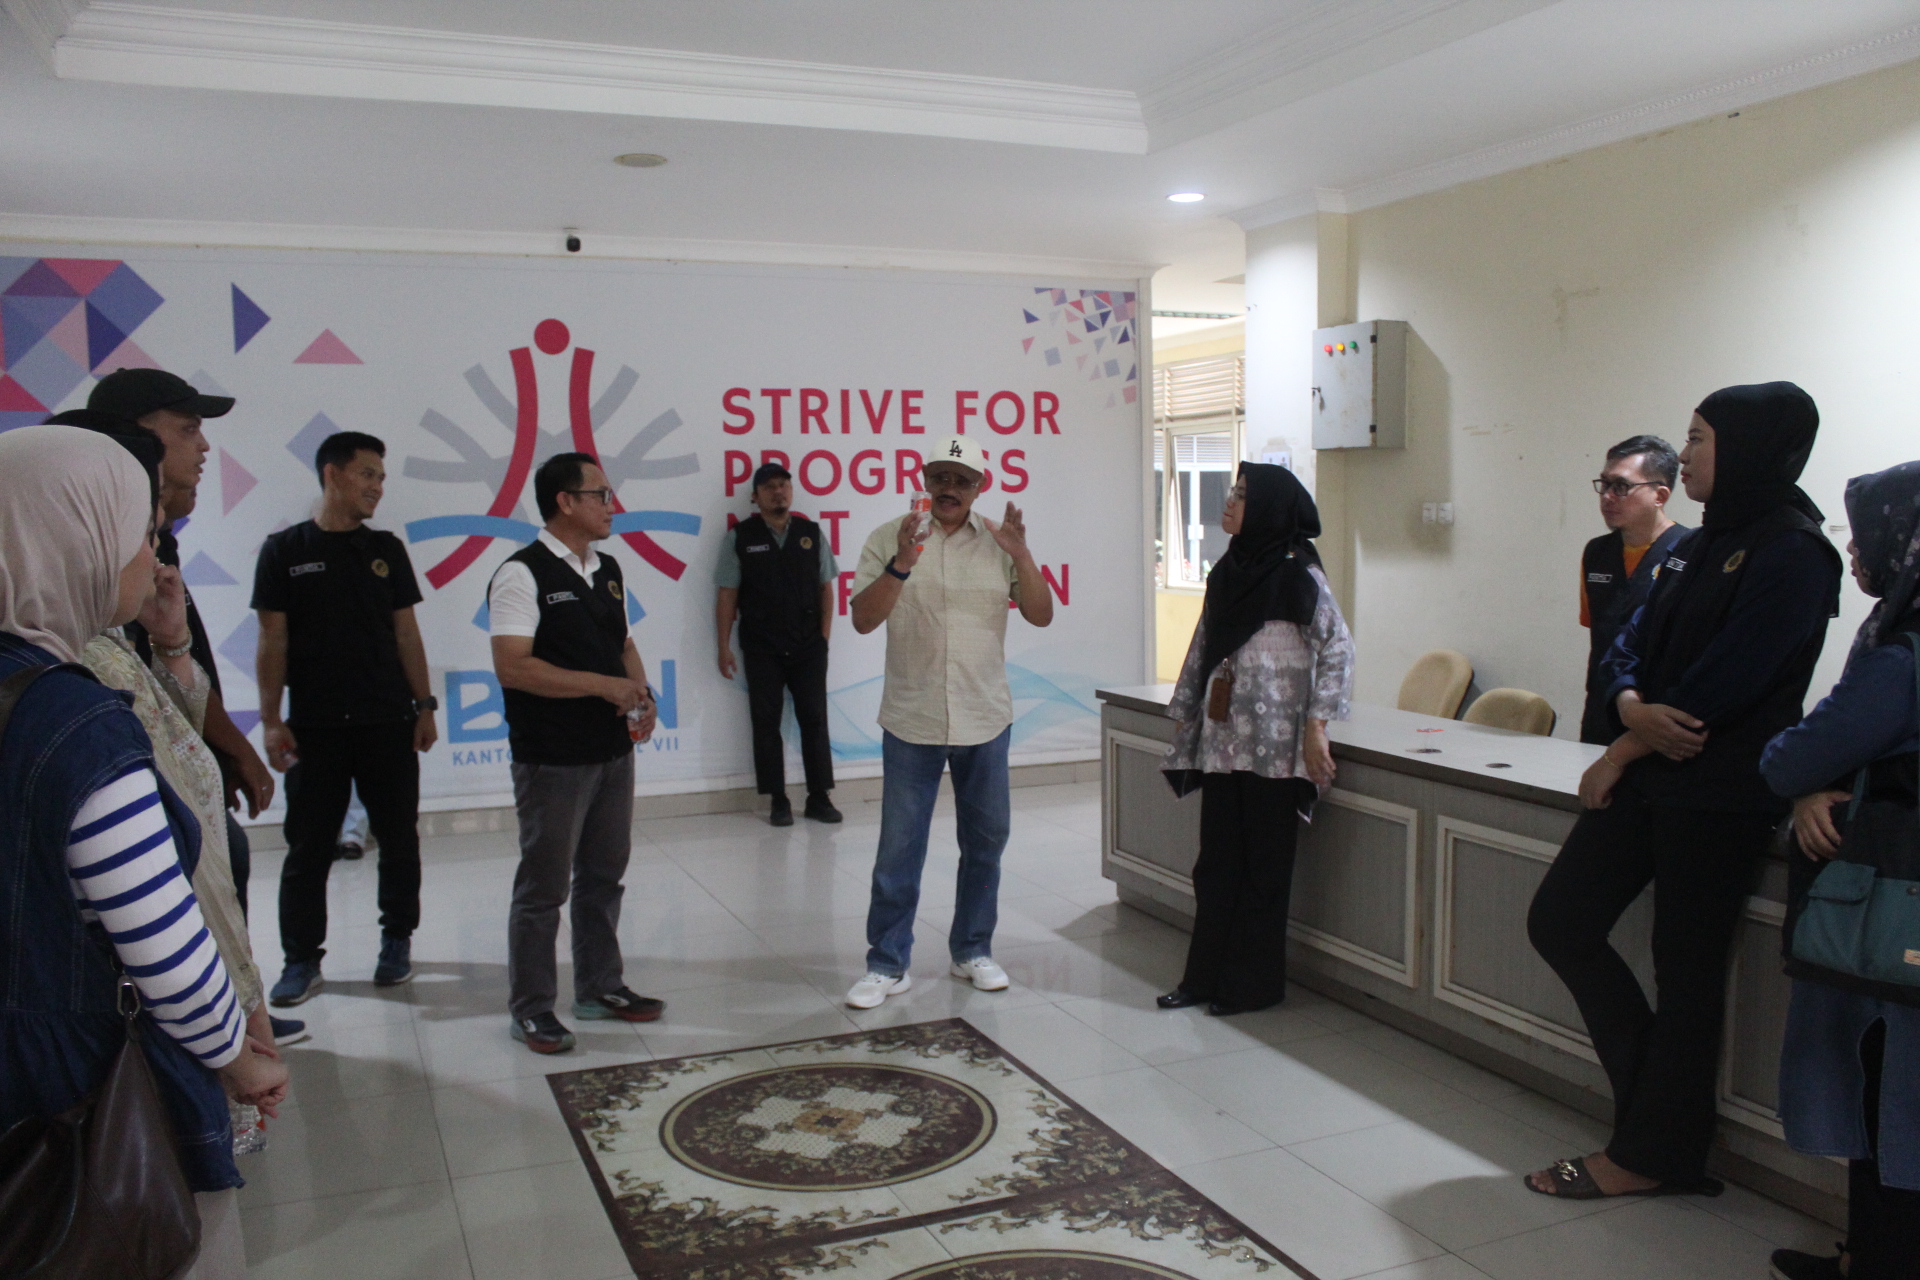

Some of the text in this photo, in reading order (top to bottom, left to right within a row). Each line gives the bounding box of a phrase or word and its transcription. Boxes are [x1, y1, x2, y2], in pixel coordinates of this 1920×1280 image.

[722, 387, 1061, 435] STRIVE FOR
[949, 440, 962, 457] LA
[724, 448, 1030, 497] POGRS
[452, 748, 513, 766] KANT
[652, 736, 679, 752] VII
